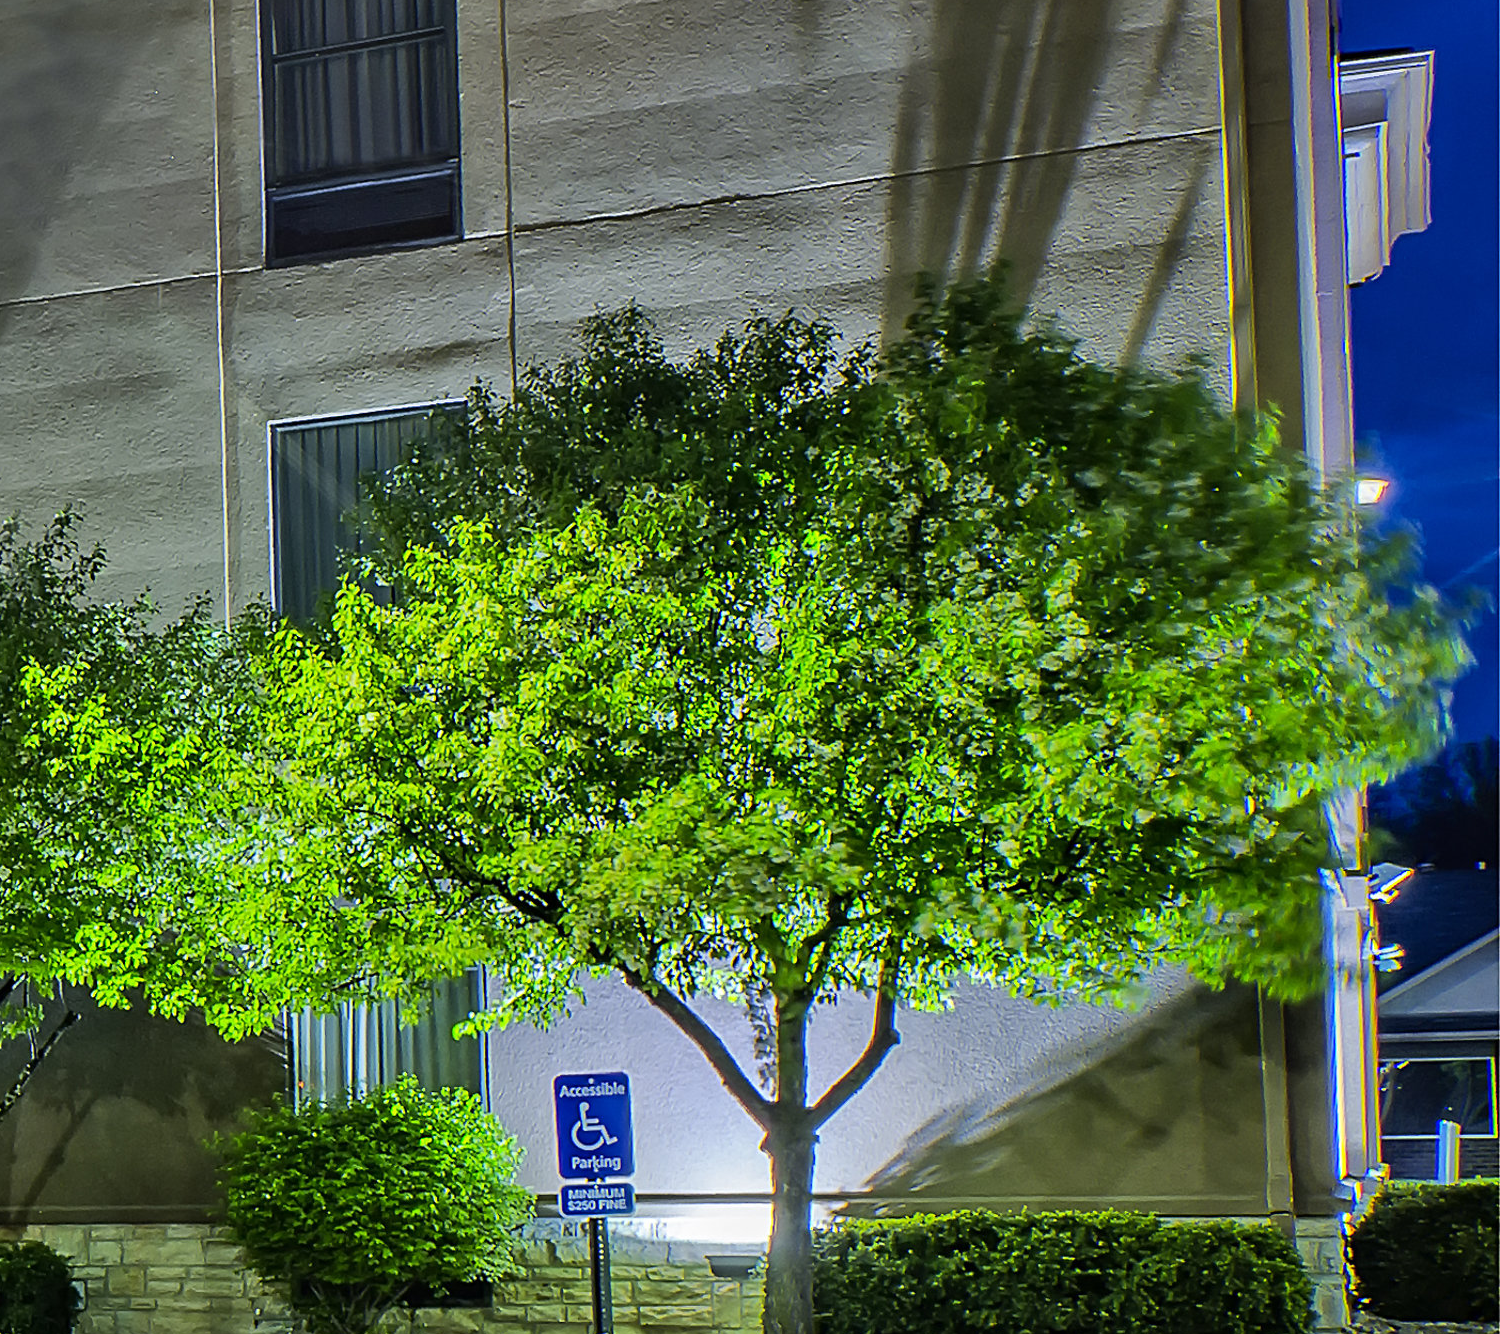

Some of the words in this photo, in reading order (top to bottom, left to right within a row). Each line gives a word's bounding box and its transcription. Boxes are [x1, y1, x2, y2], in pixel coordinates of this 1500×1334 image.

[559, 1081, 626, 1098] Accessible
[571, 1155, 622, 1171] Parking
[568, 1187, 625, 1199] MINIMUM
[567, 1199, 596, 1211] $250
[598, 1198, 627, 1210] FINE
